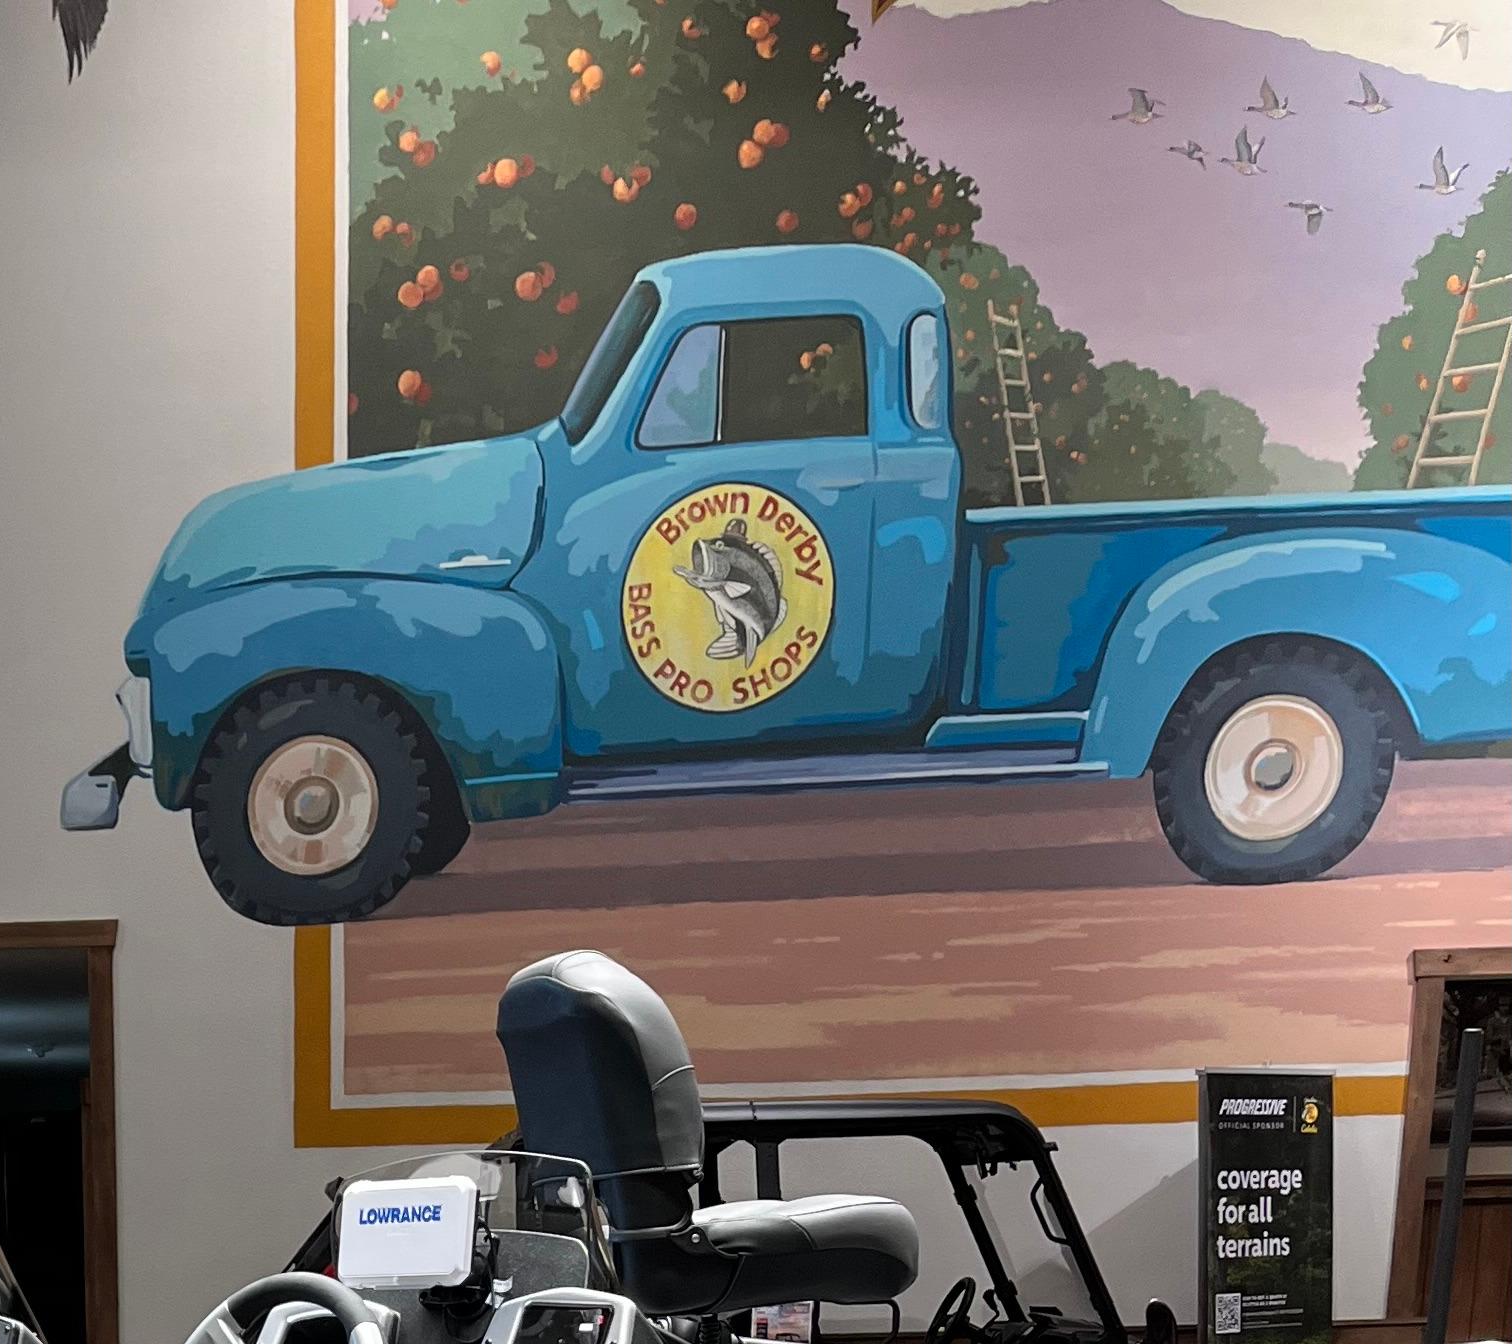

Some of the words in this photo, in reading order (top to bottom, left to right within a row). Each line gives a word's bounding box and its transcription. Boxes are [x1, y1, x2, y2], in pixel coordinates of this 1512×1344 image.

[656, 491, 750, 546] Brown
[756, 495, 824, 587] Derby
[628, 582, 661, 659] BASS
[653, 658, 714, 704] PRO
[731, 625, 818, 705] SHOPS
[1218, 1098, 1288, 1116] PROGRESSIVE
[1216, 1169, 1303, 1195] coverage
[358, 1205, 442, 1225] LOWRANCE
[1216, 1196, 1246, 1225] for
[1247, 1196, 1273, 1224] all
[1216, 1230, 1291, 1259] terrains
